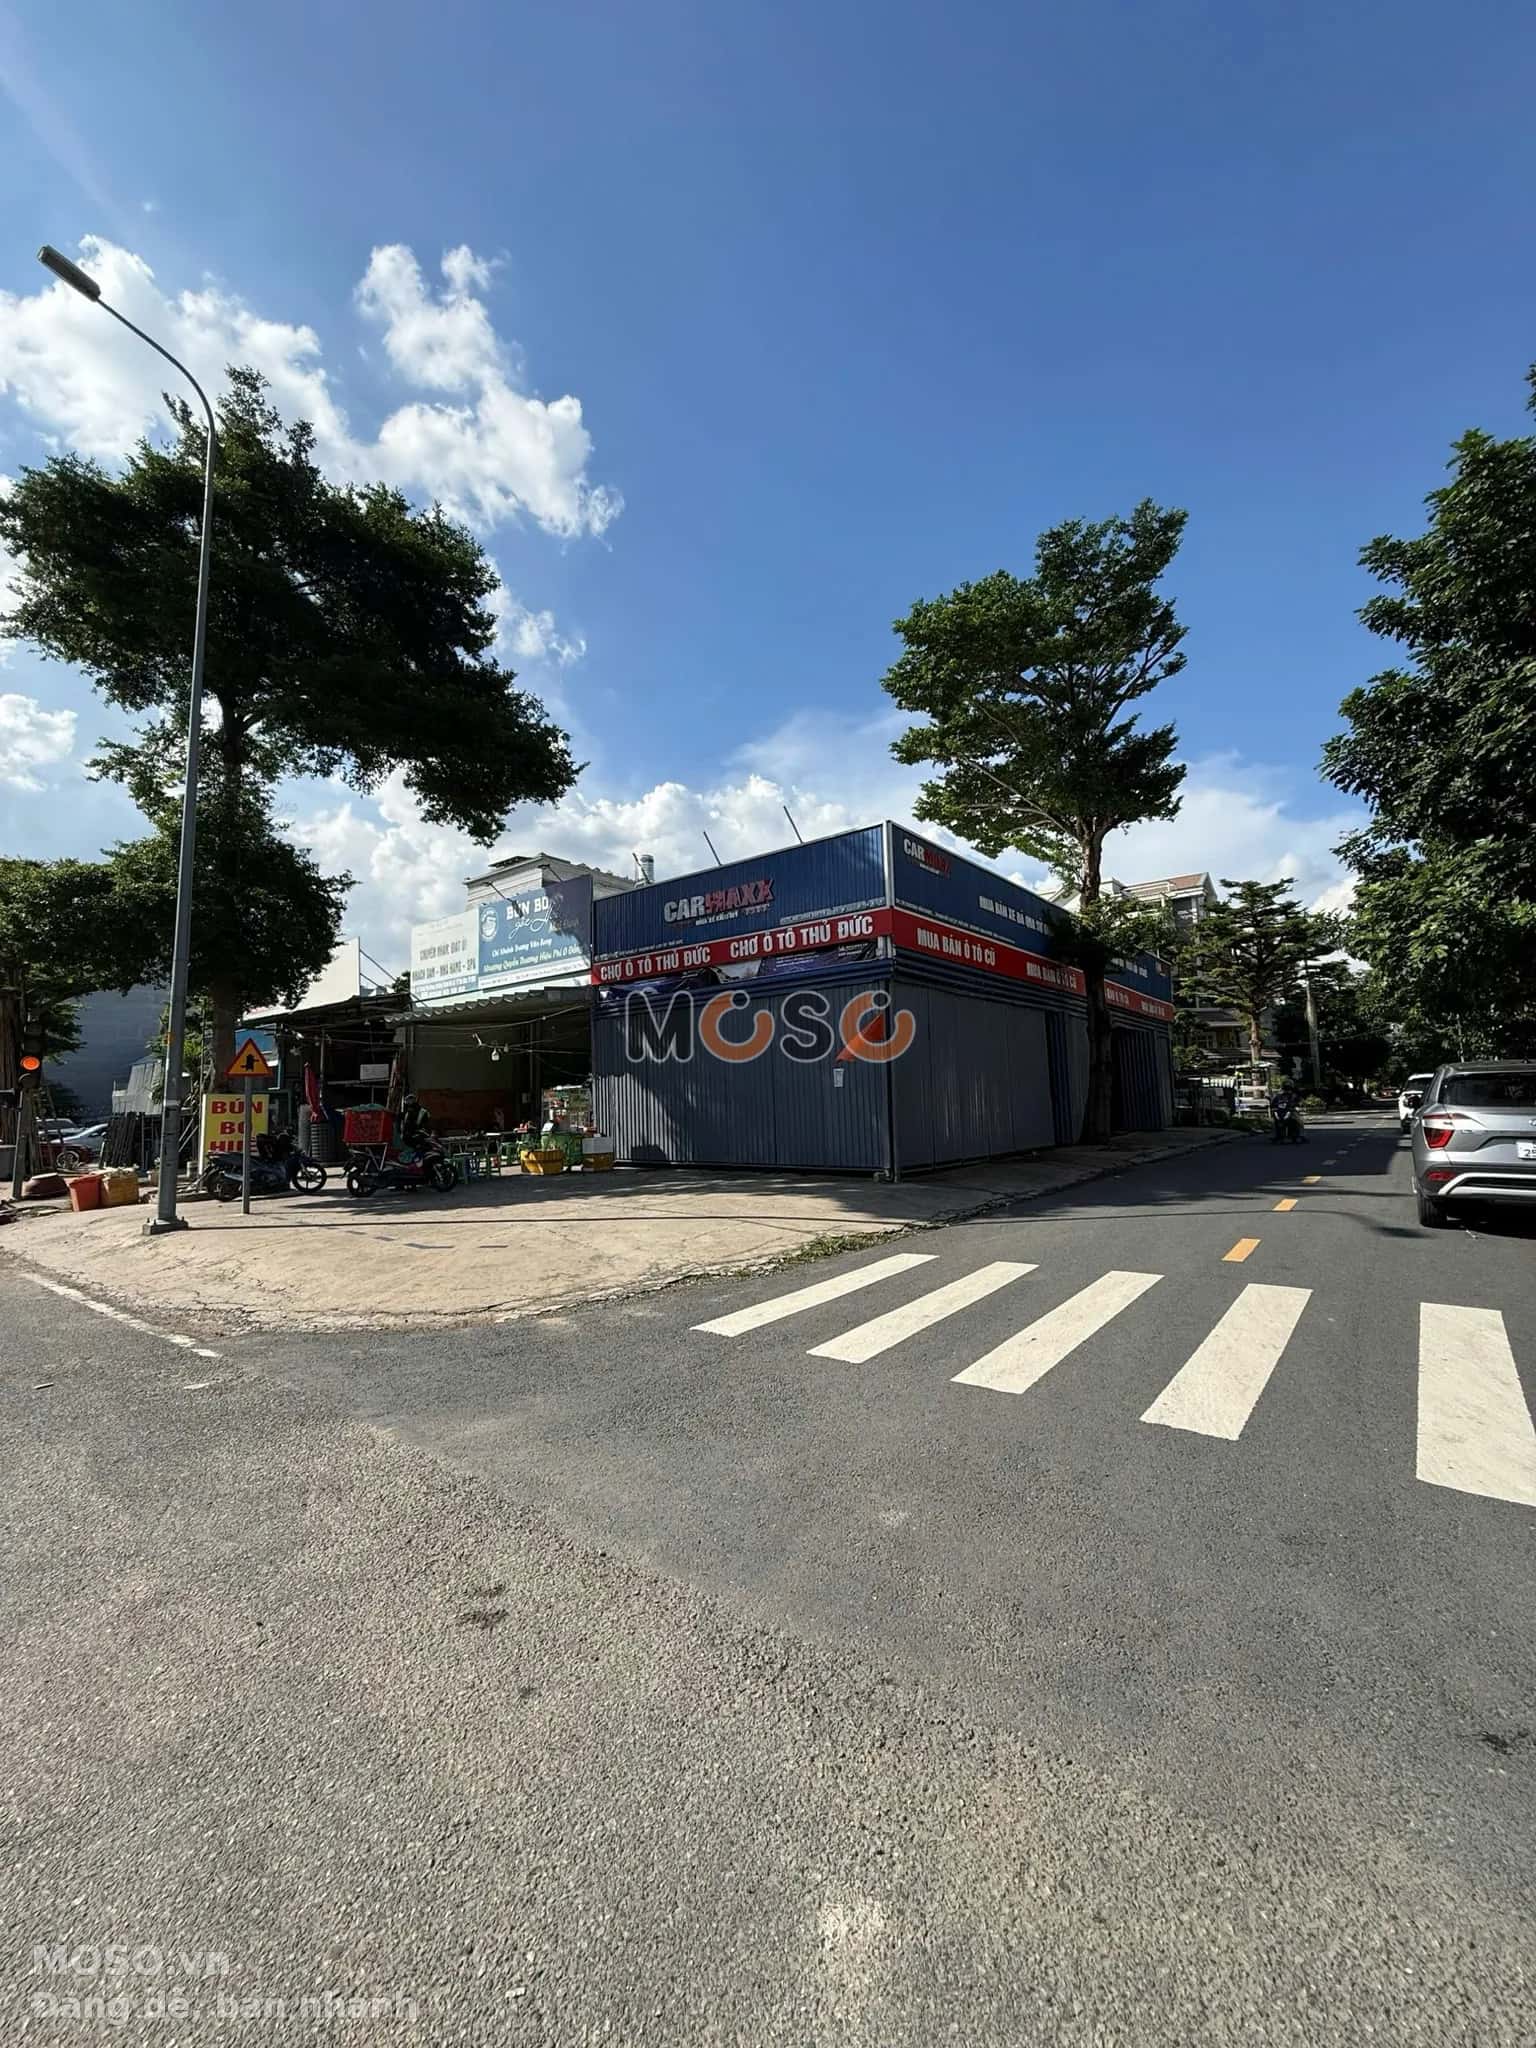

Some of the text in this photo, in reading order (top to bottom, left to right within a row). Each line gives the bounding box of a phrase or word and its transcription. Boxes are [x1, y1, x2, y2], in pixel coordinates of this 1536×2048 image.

[763, 931, 773, 953] Ô
[777, 927, 796, 950] TÔ
[801, 919, 831, 946] THỦ
[837, 914, 873, 939] ĐỨC
[916, 927, 940, 951] MUA
[942, 933, 962, 957] BÁN
[963, 939, 971, 959] Ô
[972, 943, 983, 963] TÔ
[984, 946, 996, 967] CŨ
[625, 959, 634, 977] Ô
[637, 958, 652, 975] TÔ
[655, 951, 679, 972] THỦ
[683, 944, 711, 967] ĐỨC
[211, 1098, 263, 1114] BÚN
